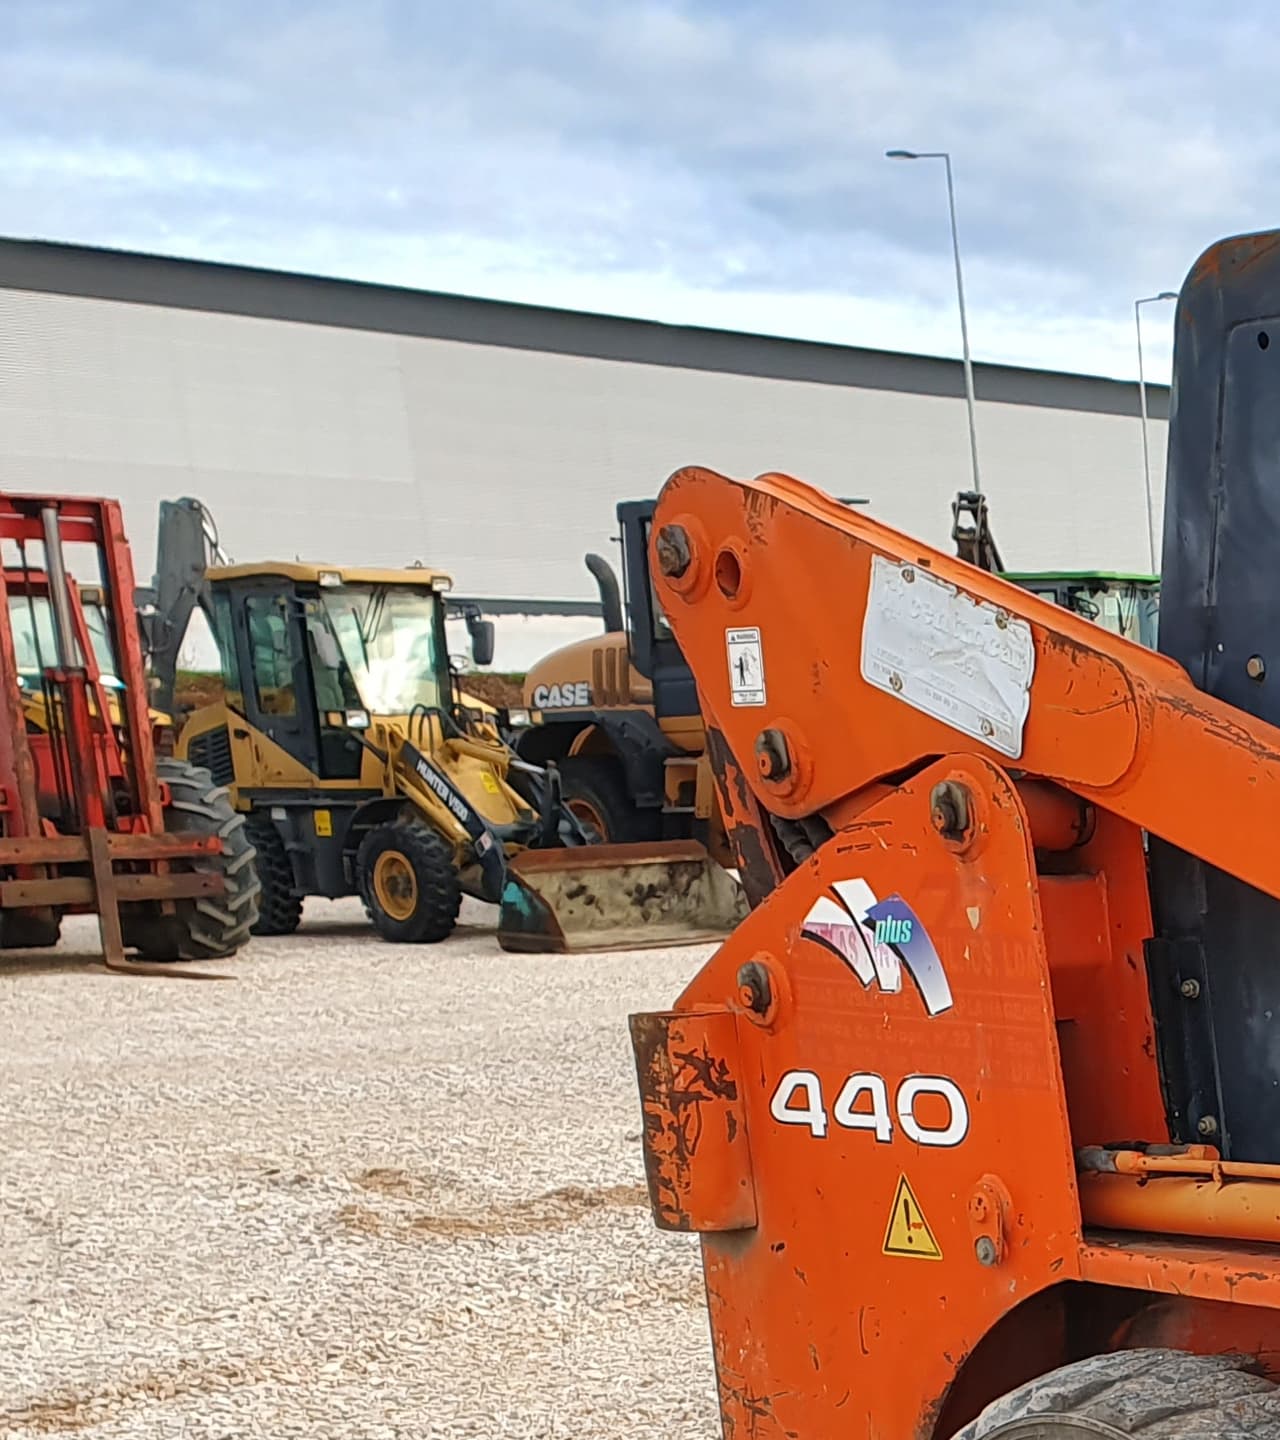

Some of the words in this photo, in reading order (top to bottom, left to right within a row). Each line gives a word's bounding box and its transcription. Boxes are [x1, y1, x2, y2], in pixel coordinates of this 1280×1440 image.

[534, 682, 589, 708] CASE
[416, 759, 450, 802] HUNTER
[874, 914, 914, 947] plus
[769, 1069, 970, 1149] 440
